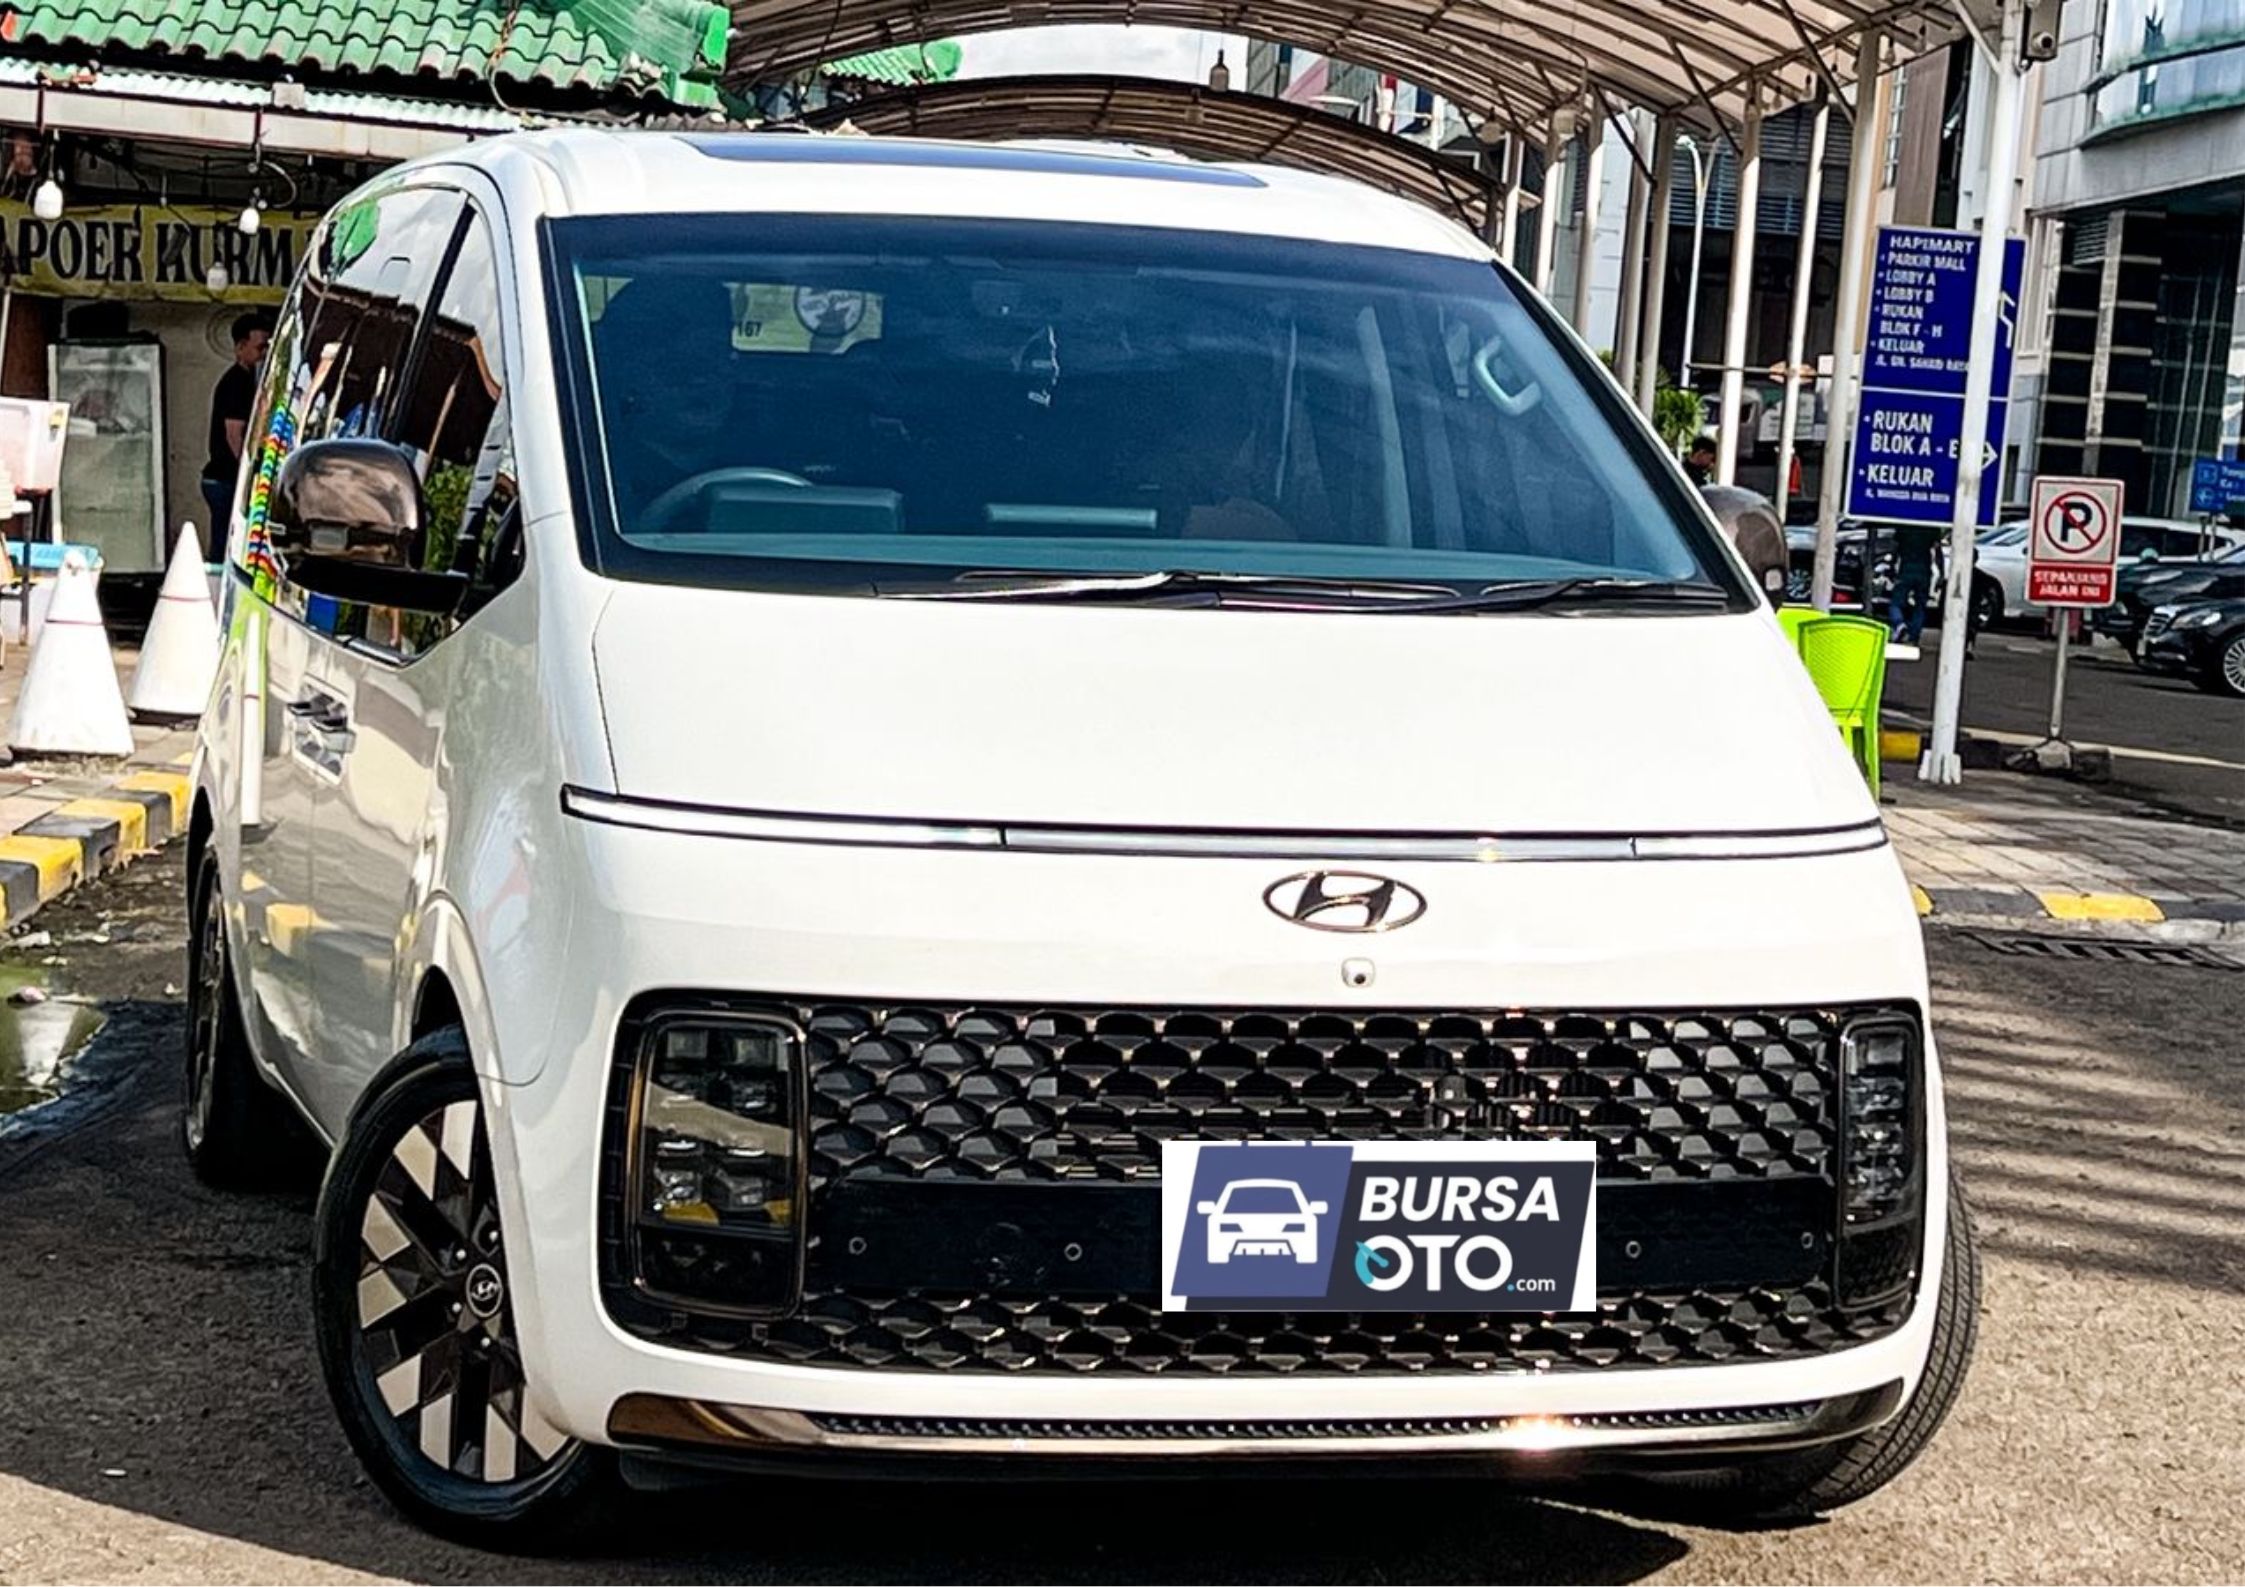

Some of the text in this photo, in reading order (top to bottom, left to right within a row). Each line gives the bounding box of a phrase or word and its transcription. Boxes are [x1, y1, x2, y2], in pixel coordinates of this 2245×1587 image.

[1934, 256, 1966, 271] MALL
[1886, 270, 1936, 286] LOBBY A
[1884, 286, 1923, 301] LOBBY
[1882, 303, 1924, 319] RUKAN
[1880, 320, 1910, 335] BLOK
[1878, 338, 1925, 354] KELUAR
[1872, 410, 1933, 434] RUKAN
[1870, 432, 1916, 455] BLOK
[1918, 436, 1931, 456] A
[1948, 438, 1959, 459] E
[1867, 463, 1935, 488] KELUAR
